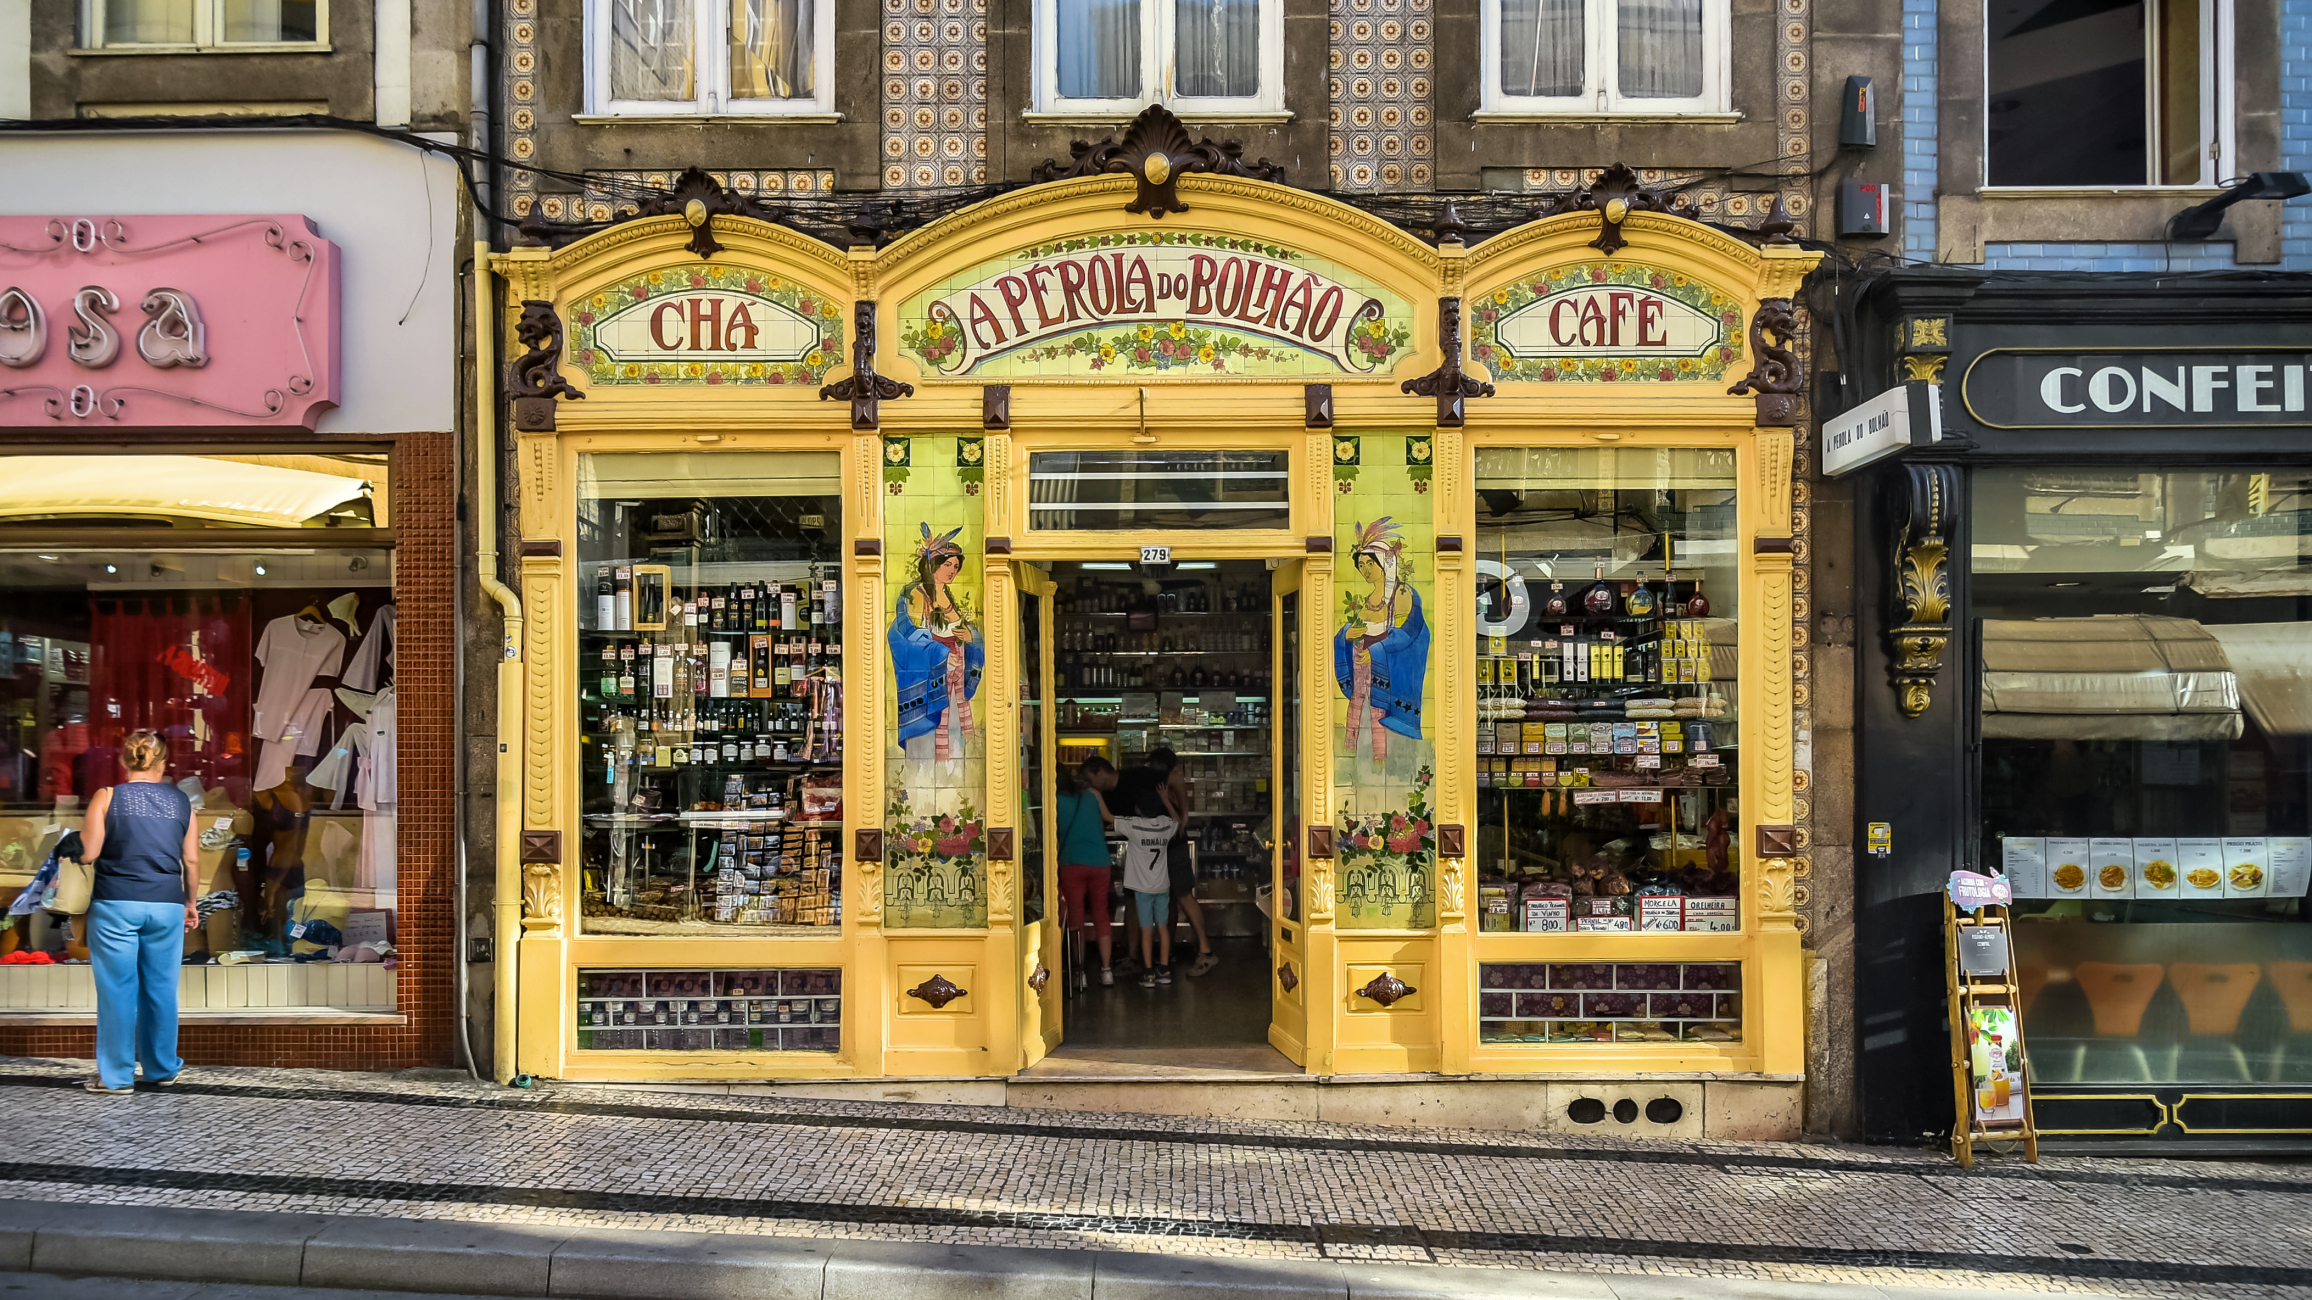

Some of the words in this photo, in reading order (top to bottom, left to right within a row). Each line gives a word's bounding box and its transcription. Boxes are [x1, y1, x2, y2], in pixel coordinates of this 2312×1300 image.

[968, 291, 1007, 350] A
[993, 251, 1157, 337] PÉROLA
[1157, 271, 1189, 300] DO
[1185, 252, 1345, 343] BOLHÃO
[650, 299, 760, 352] CHÁ
[1548, 292, 1668, 347] CAFÉ
[2040, 365, 2312, 413] CONFEI
[1826, 438, 1831, 454] A
[1856, 423, 1864, 441] DO
[1143, 549, 1167, 561] 279
[1149, 848, 1160, 870] 7
[1644, 899, 1677, 908] MORCELA
[1690, 900, 1725, 909] ORELHEIRA
[1958, 885, 1991, 898] FRUTOLOGIA
